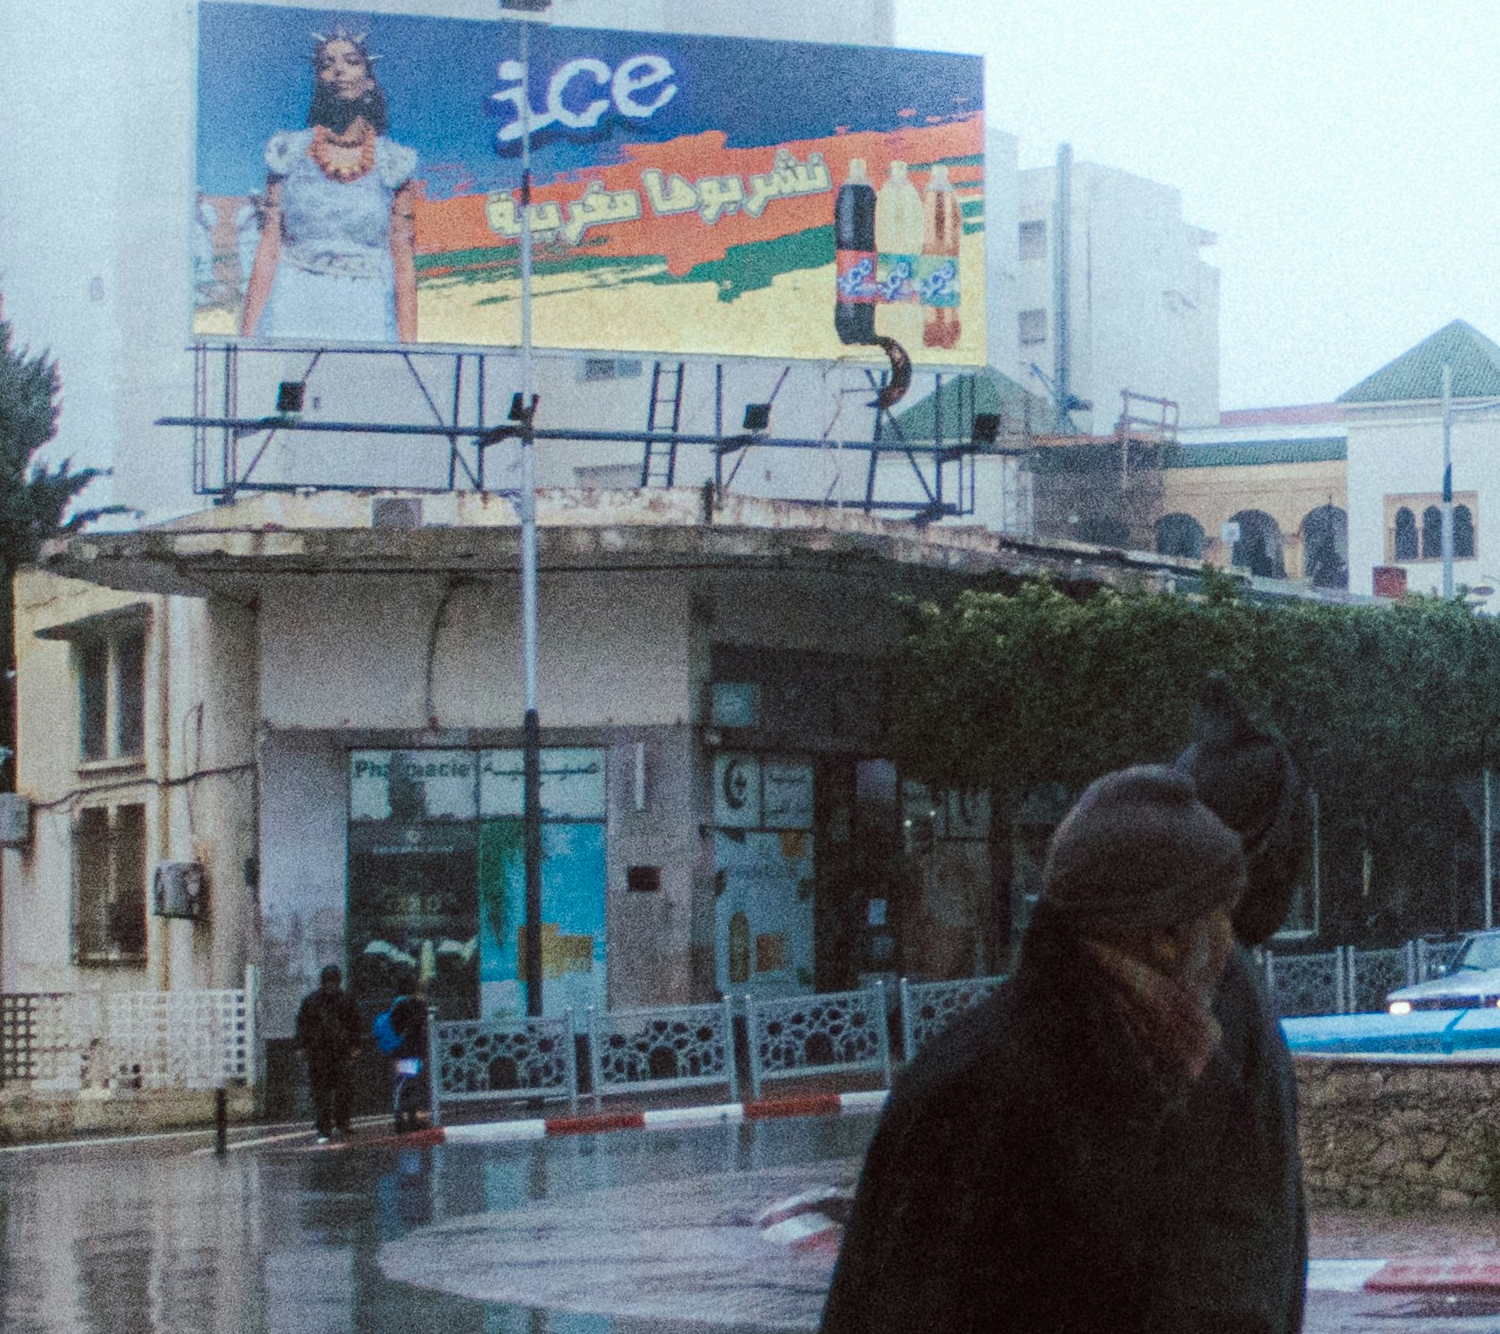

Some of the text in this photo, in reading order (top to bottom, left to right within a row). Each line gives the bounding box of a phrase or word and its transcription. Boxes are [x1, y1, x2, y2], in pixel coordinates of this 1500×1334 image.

[491, 52, 678, 143] ice
[486, 148, 833, 247] نشربوها مغربية
[354, 758, 471, 779] Phamacie
